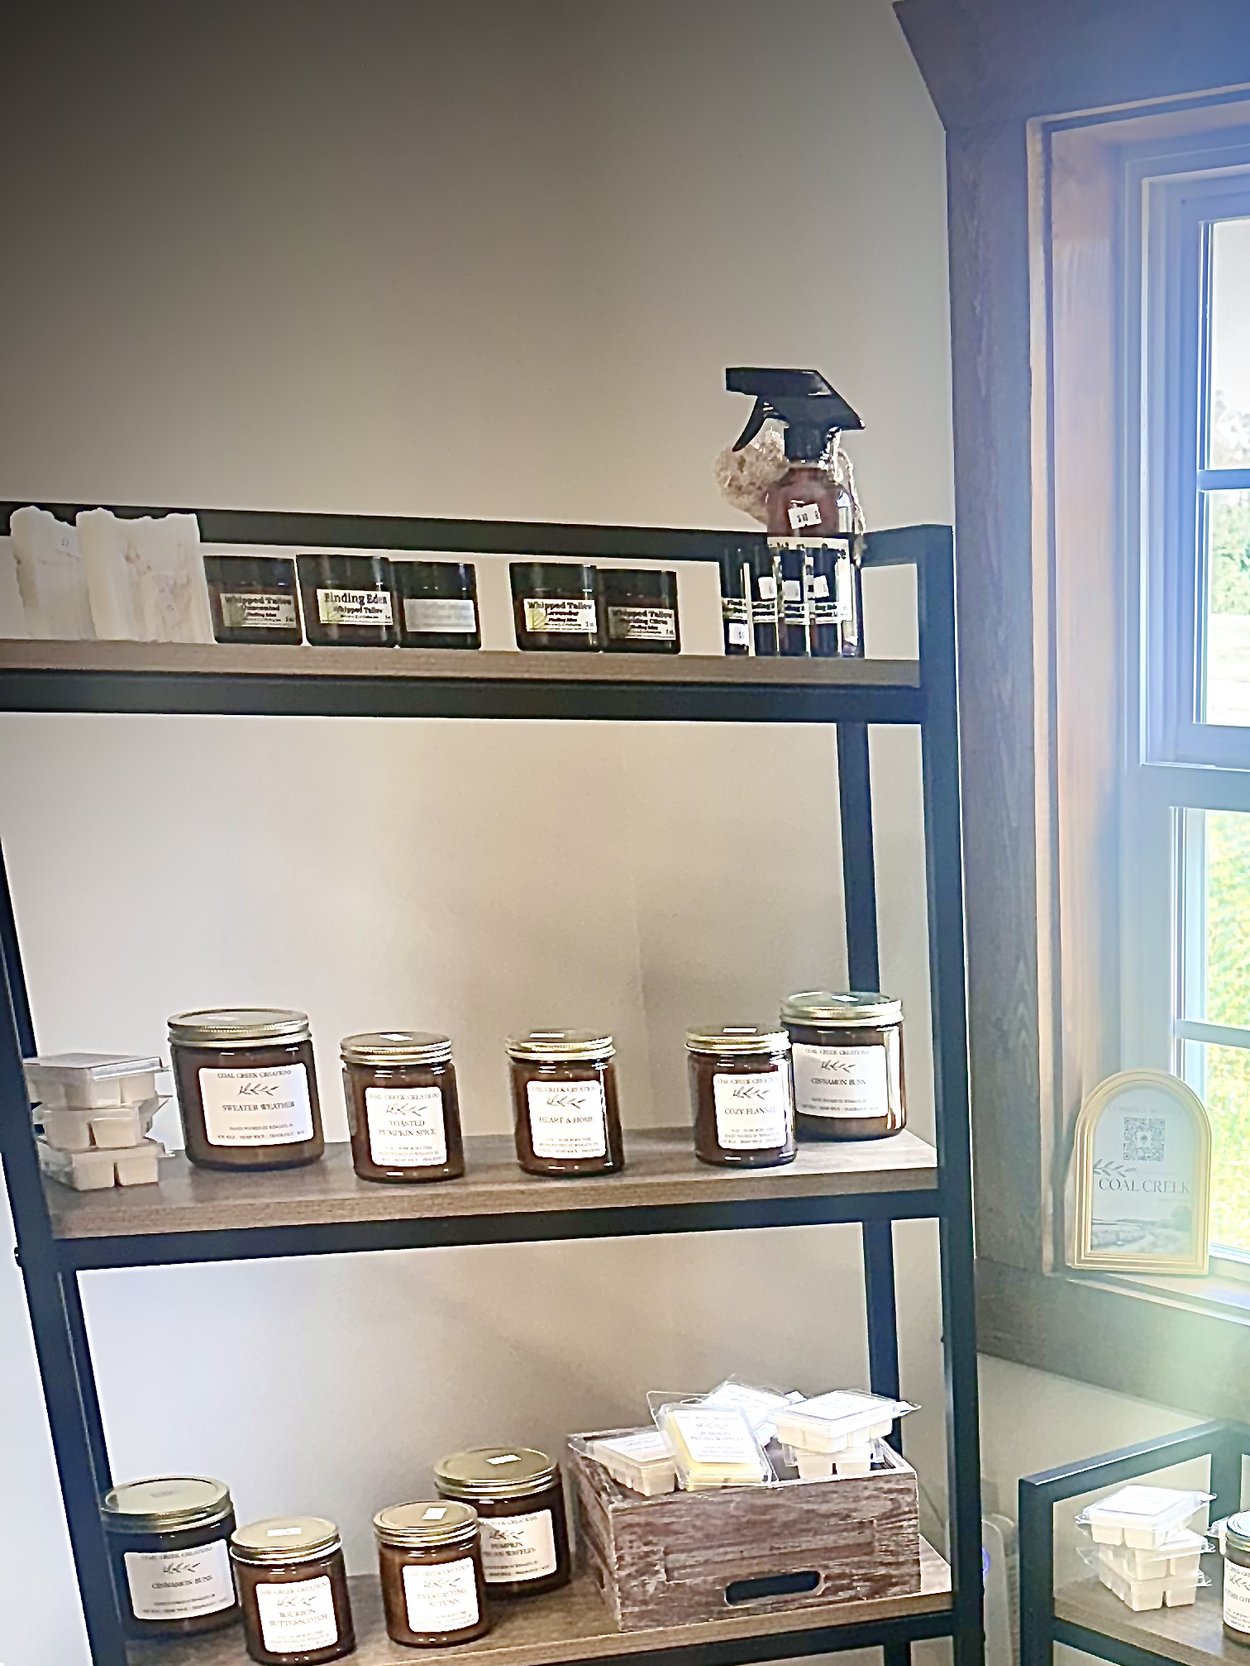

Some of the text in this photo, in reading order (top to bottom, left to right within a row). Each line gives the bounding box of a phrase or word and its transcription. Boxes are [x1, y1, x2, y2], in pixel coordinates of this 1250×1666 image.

[324, 592, 365, 606] Finding
[527, 601, 566, 611] Whipped
[811, 1078, 848, 1086] CINNAMON
[222, 1101, 295, 1112] SWEATER WEATHER
[724, 1107, 745, 1115] COZY
[389, 1119, 426, 1127] TOASTED
[539, 1116, 563, 1124] HEART
[378, 1129, 414, 1137] PUMPKIN
[1098, 1178, 1191, 1194] COAL CREEK
[194, 1575, 213, 1585] BUNS
